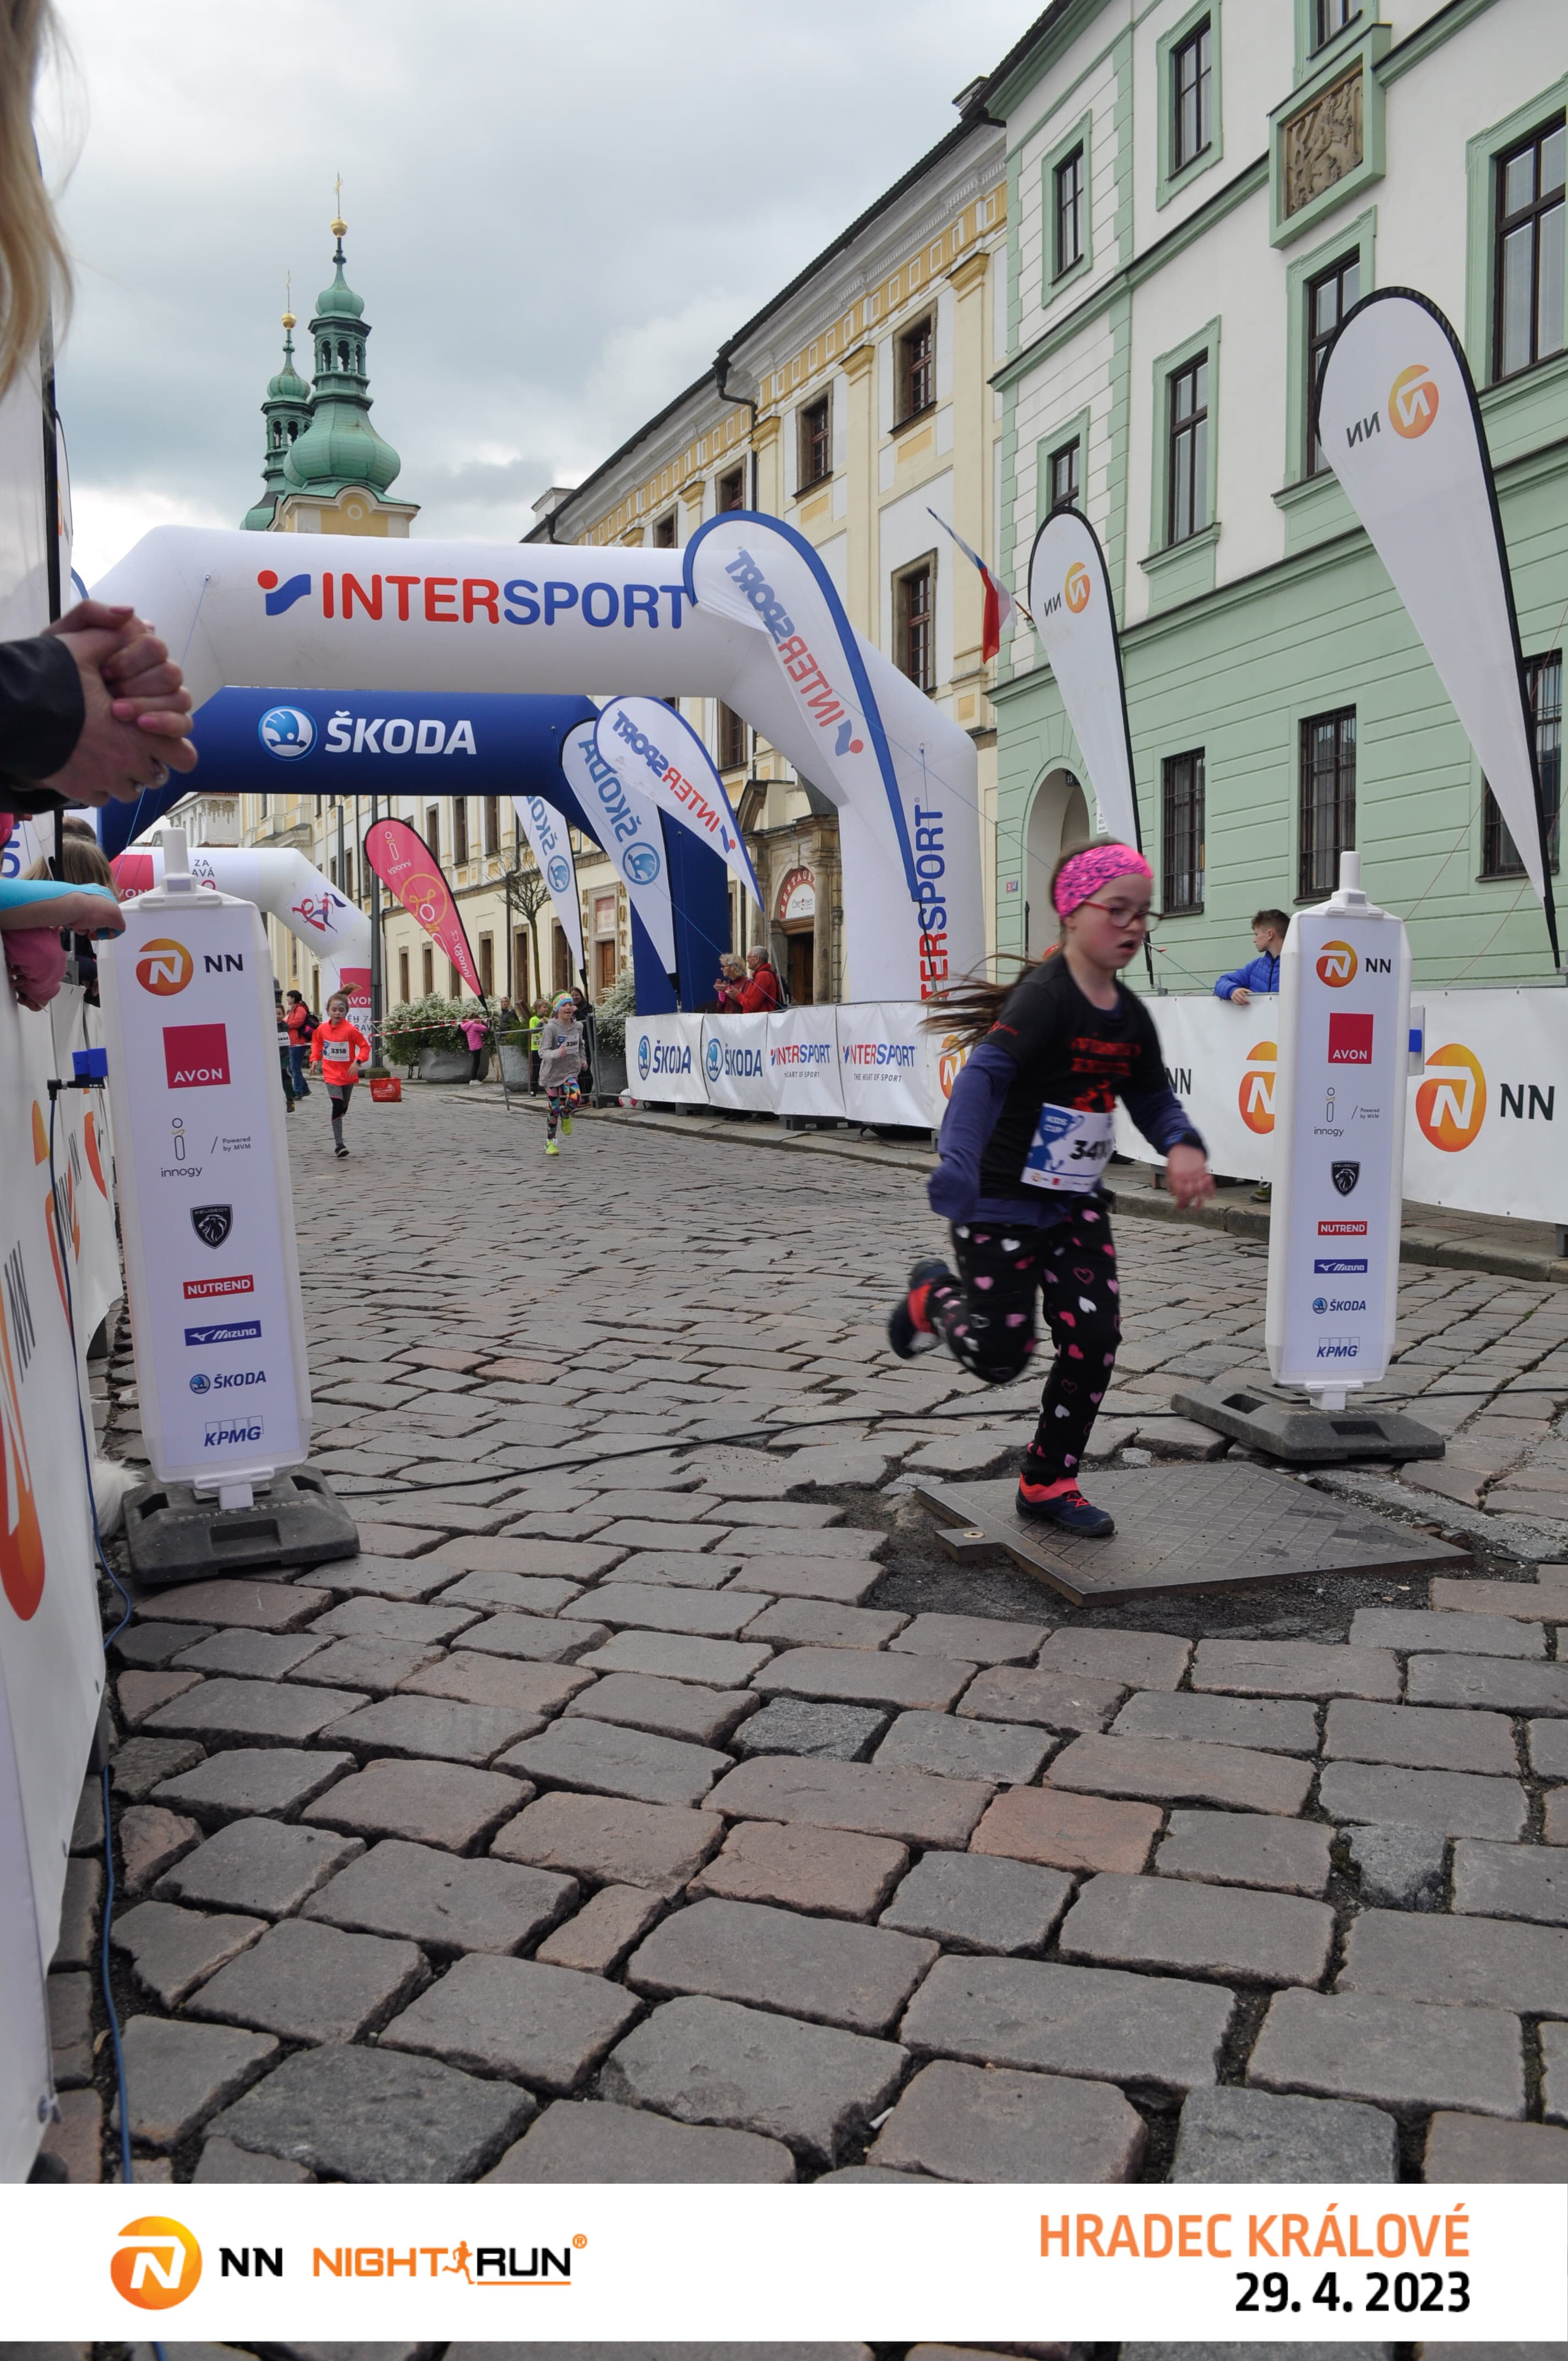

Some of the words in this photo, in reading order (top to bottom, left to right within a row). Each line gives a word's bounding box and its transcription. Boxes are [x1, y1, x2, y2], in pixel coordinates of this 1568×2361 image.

[323, 572, 688, 629] INTERSPORT
[325, 710, 477, 755] ŠKODA
[118, 888, 147, 899] VON
[915, 804, 949, 1000] TERSPORT
[203, 954, 243, 973] NN
[1365, 958, 1391, 973] NN
[652, 1040, 691, 1074] ŠKODA
[725, 1043, 763, 1077] ŠKODA
[1333, 1049, 1367, 1060] AVON
[174, 1068, 222, 1082] AVON
[881, 1074, 902, 1082] SPORT
[1500, 1083, 1555, 1121] NN
[1314, 1127, 1344, 1137] innogy
[161, 1167, 203, 1177] innogy
[1321, 1223, 1365, 1233] NUTREND
[188, 1279, 251, 1296] NUTREND
[1329, 1299, 1366, 1312] ŠKODA
[1317, 1345, 1358, 1358] KPMG
[214, 1370, 266, 1389] ŠKODA
[204, 1426, 262, 1447] KPMG
